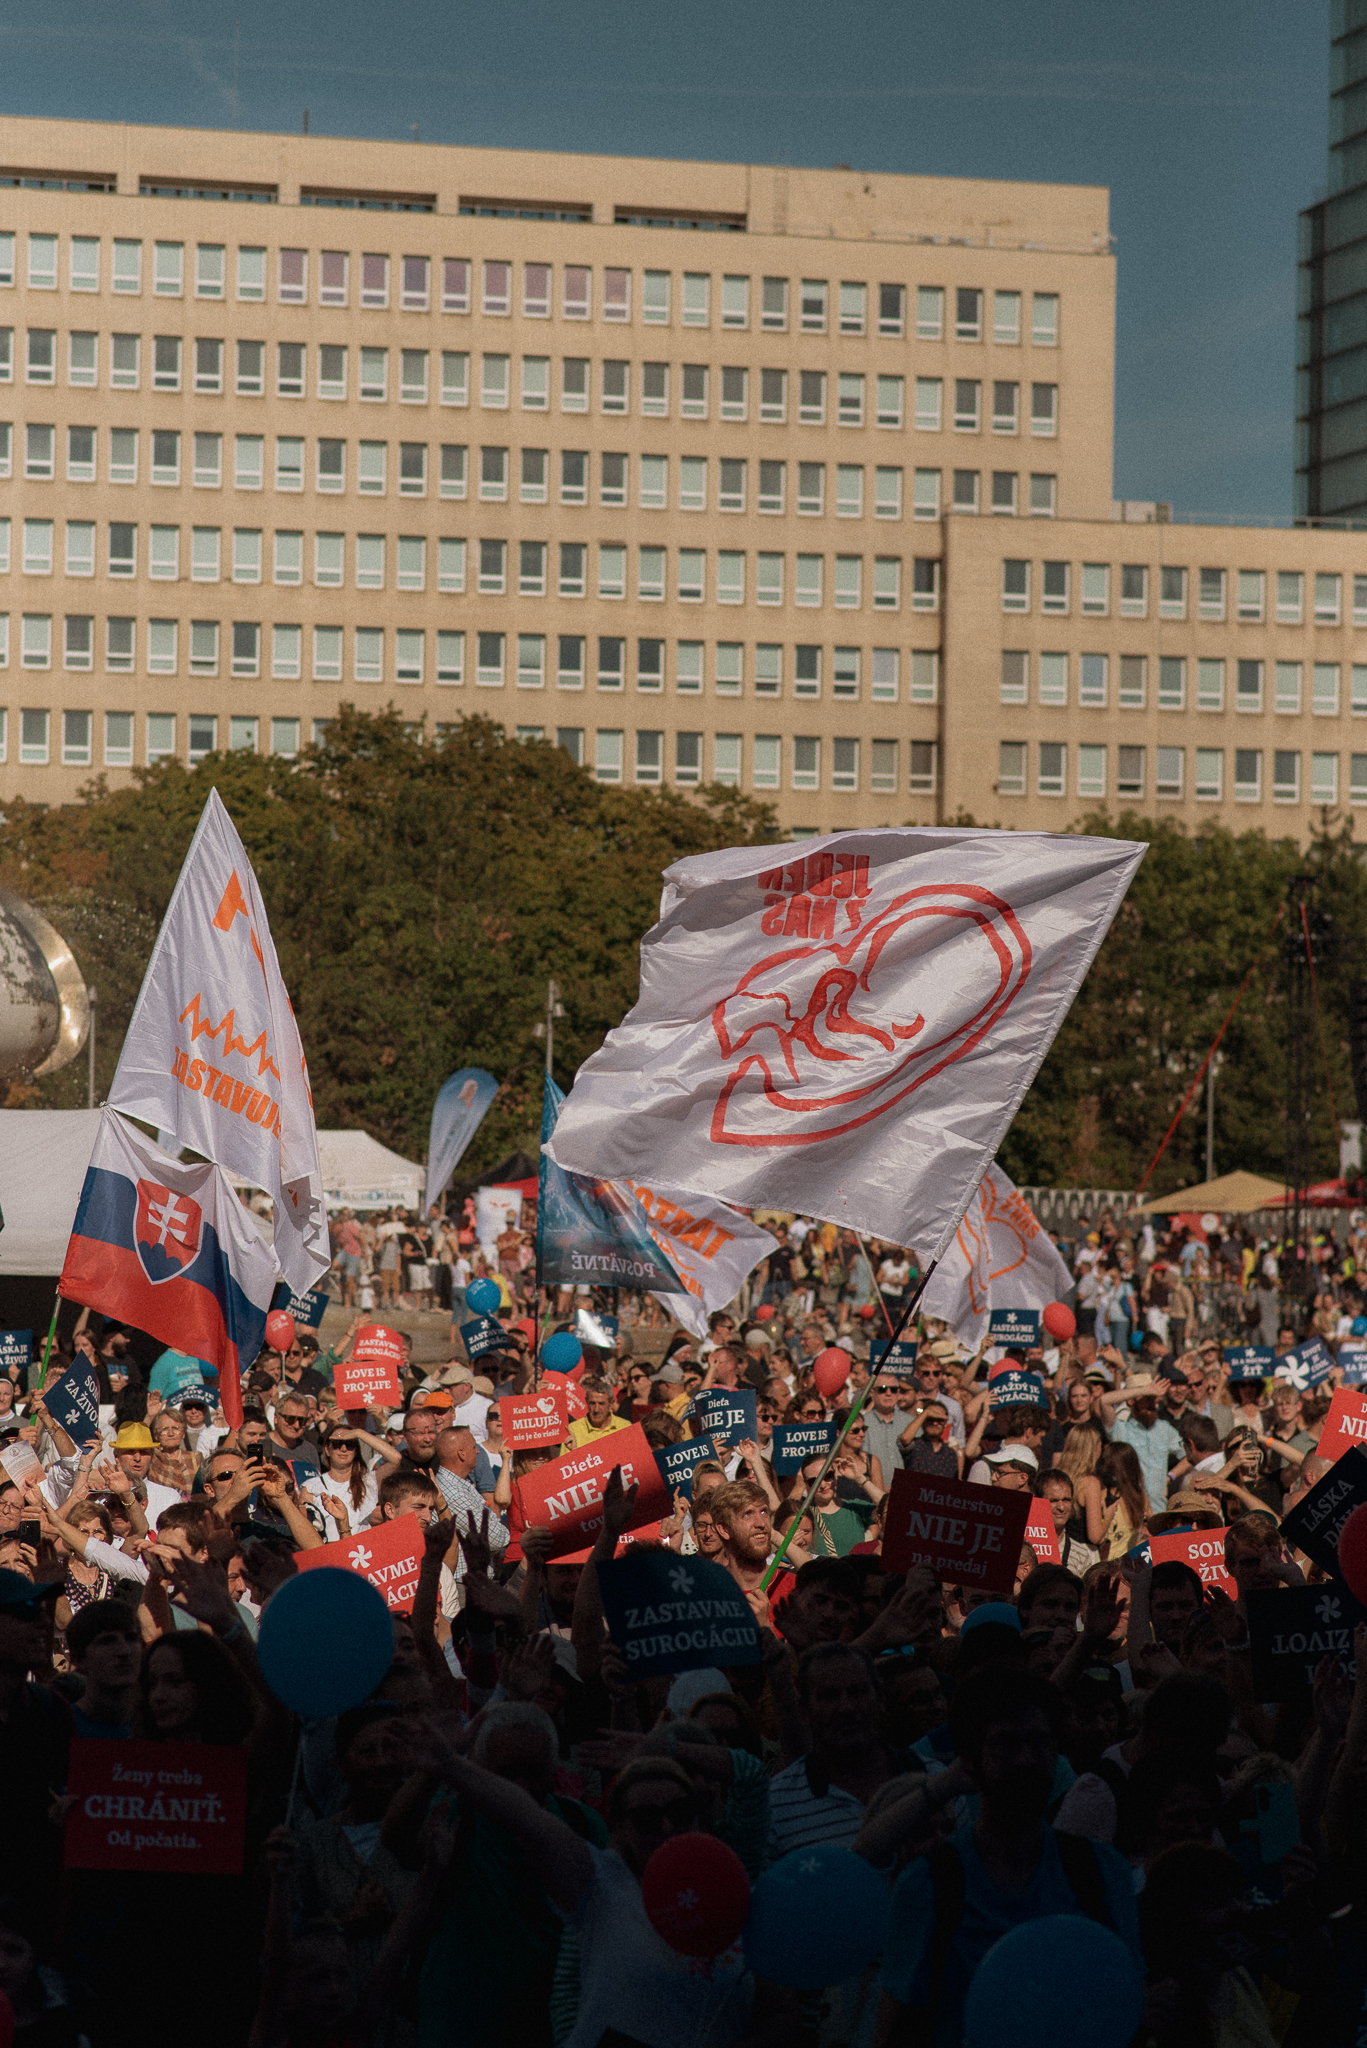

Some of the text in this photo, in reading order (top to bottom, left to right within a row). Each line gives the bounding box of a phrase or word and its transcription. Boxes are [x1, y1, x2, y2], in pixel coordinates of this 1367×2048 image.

[626, 1180, 736, 1261] OTRAT
[991, 1323, 1035, 1333] ZASTAVME
[991, 1333, 1036, 1343] UROGÁCIU
[356, 1347, 401, 1360] SUROGÁCIU
[358, 1338, 400, 1351] ZASTAVME
[874, 1354, 914, 1365] ZSTAVME
[346, 1367, 386, 1380] LOVE IS
[65, 1379, 80, 1400] ZA
[343, 1380, 392, 1393] PRO-LIFE
[993, 1381, 1040, 1395] KAŽDÝ JE
[998, 1390, 1040, 1404] VZÁCNY
[513, 1405, 538, 1415] Keď ho
[707, 1397, 730, 1409] Dieťa
[512, 1412, 562, 1431] MILUJEŠ,
[701, 1409, 746, 1431] NIE JE
[513, 1433, 525, 1441] nie
[525, 1431, 533, 1442] je
[786, 1429, 828, 1443] LOVE IS
[665, 1444, 710, 1467] LOVE IS
[559, 1453, 604, 1480] Dieťa
[543, 1463, 640, 1521] NIE E
[917, 1487, 1005, 1517] Materstvo
[1301, 1479, 1356, 1534] LÁSKA
[905, 1510, 1005, 1555] NIE JE
[911, 1551, 988, 1579] na predaj
[624, 1600, 746, 1630] ZASTAVME
[624, 1623, 759, 1661] SUROGÁCIU
[1271, 1628, 1351, 1656] ŽIVOT
[111, 1761, 203, 1788] Ženy treba
[84, 1790, 227, 1824] CHRÁNIŤ.
[106, 1829, 203, 1852] Od počatia.
